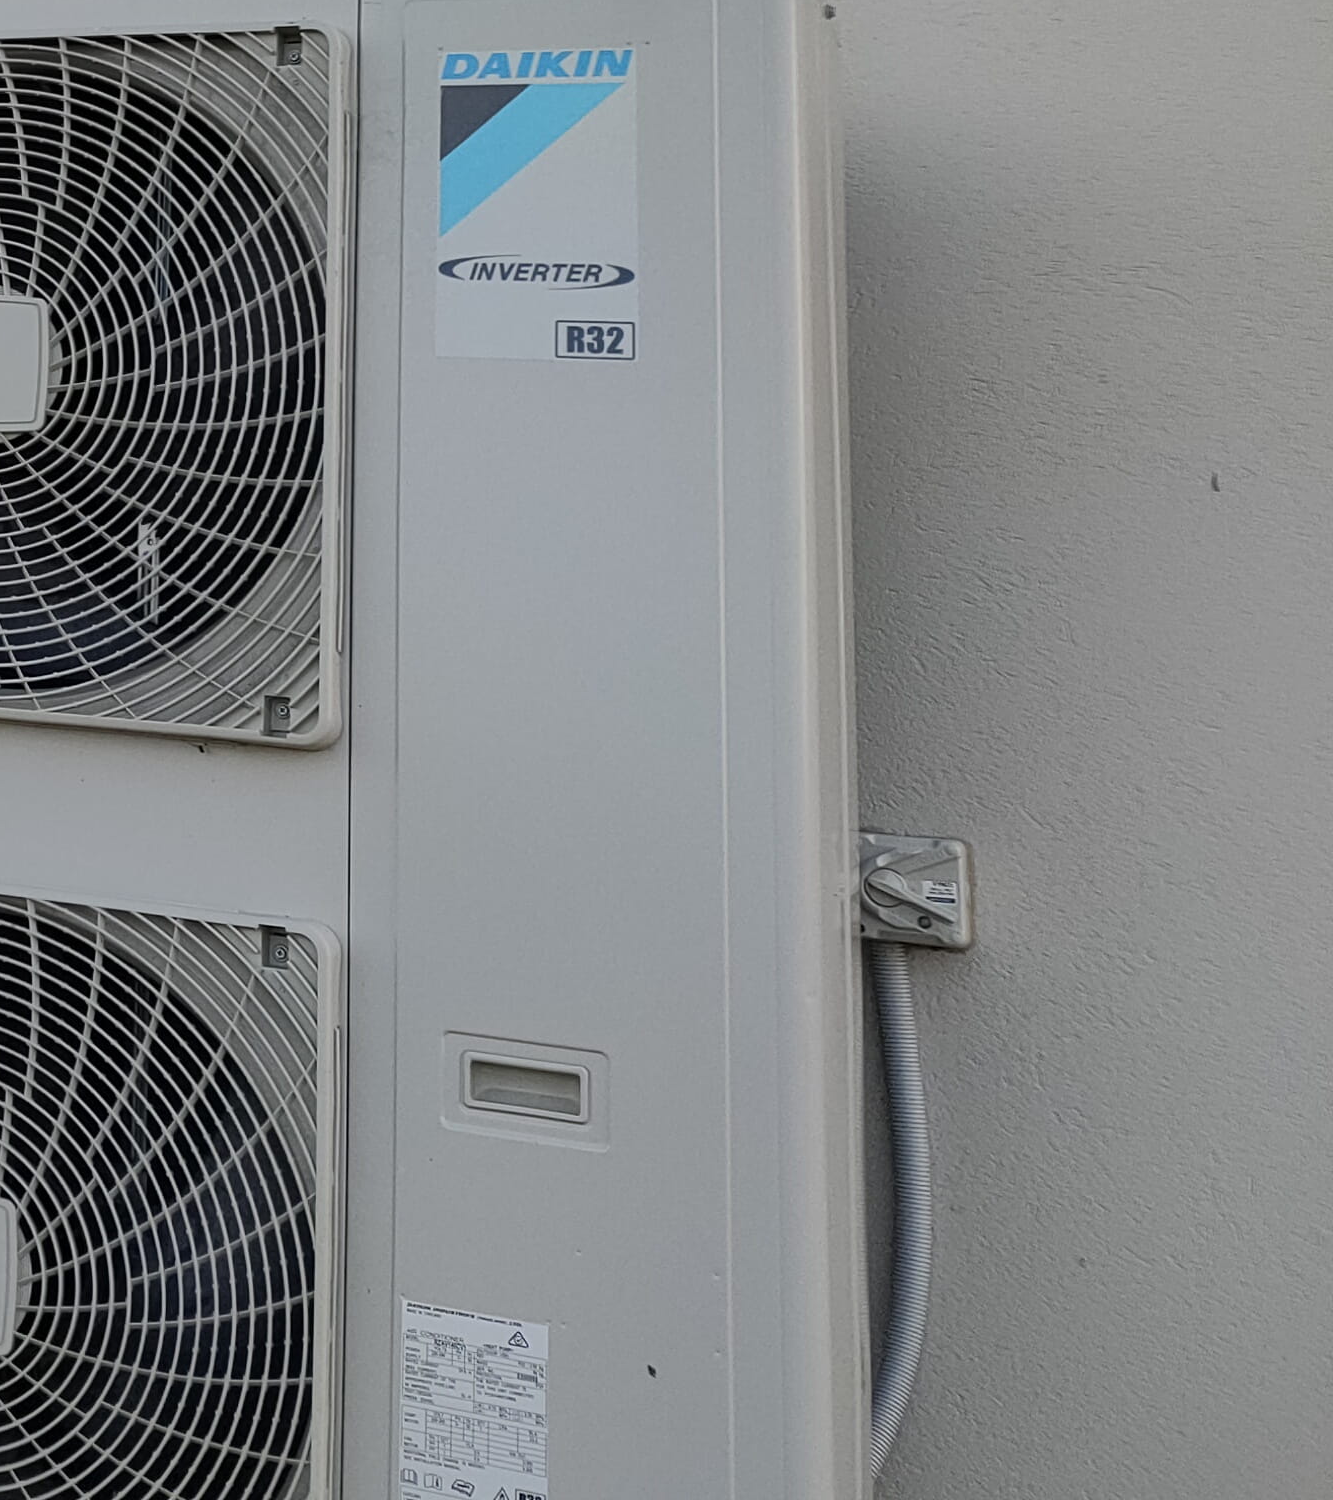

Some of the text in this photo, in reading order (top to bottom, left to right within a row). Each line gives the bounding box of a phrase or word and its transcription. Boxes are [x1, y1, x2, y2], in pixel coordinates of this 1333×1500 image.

[440, 49, 633, 80] DAIKIN
[469, 263, 604, 283] INVERTER
[566, 326, 625, 354] R32
